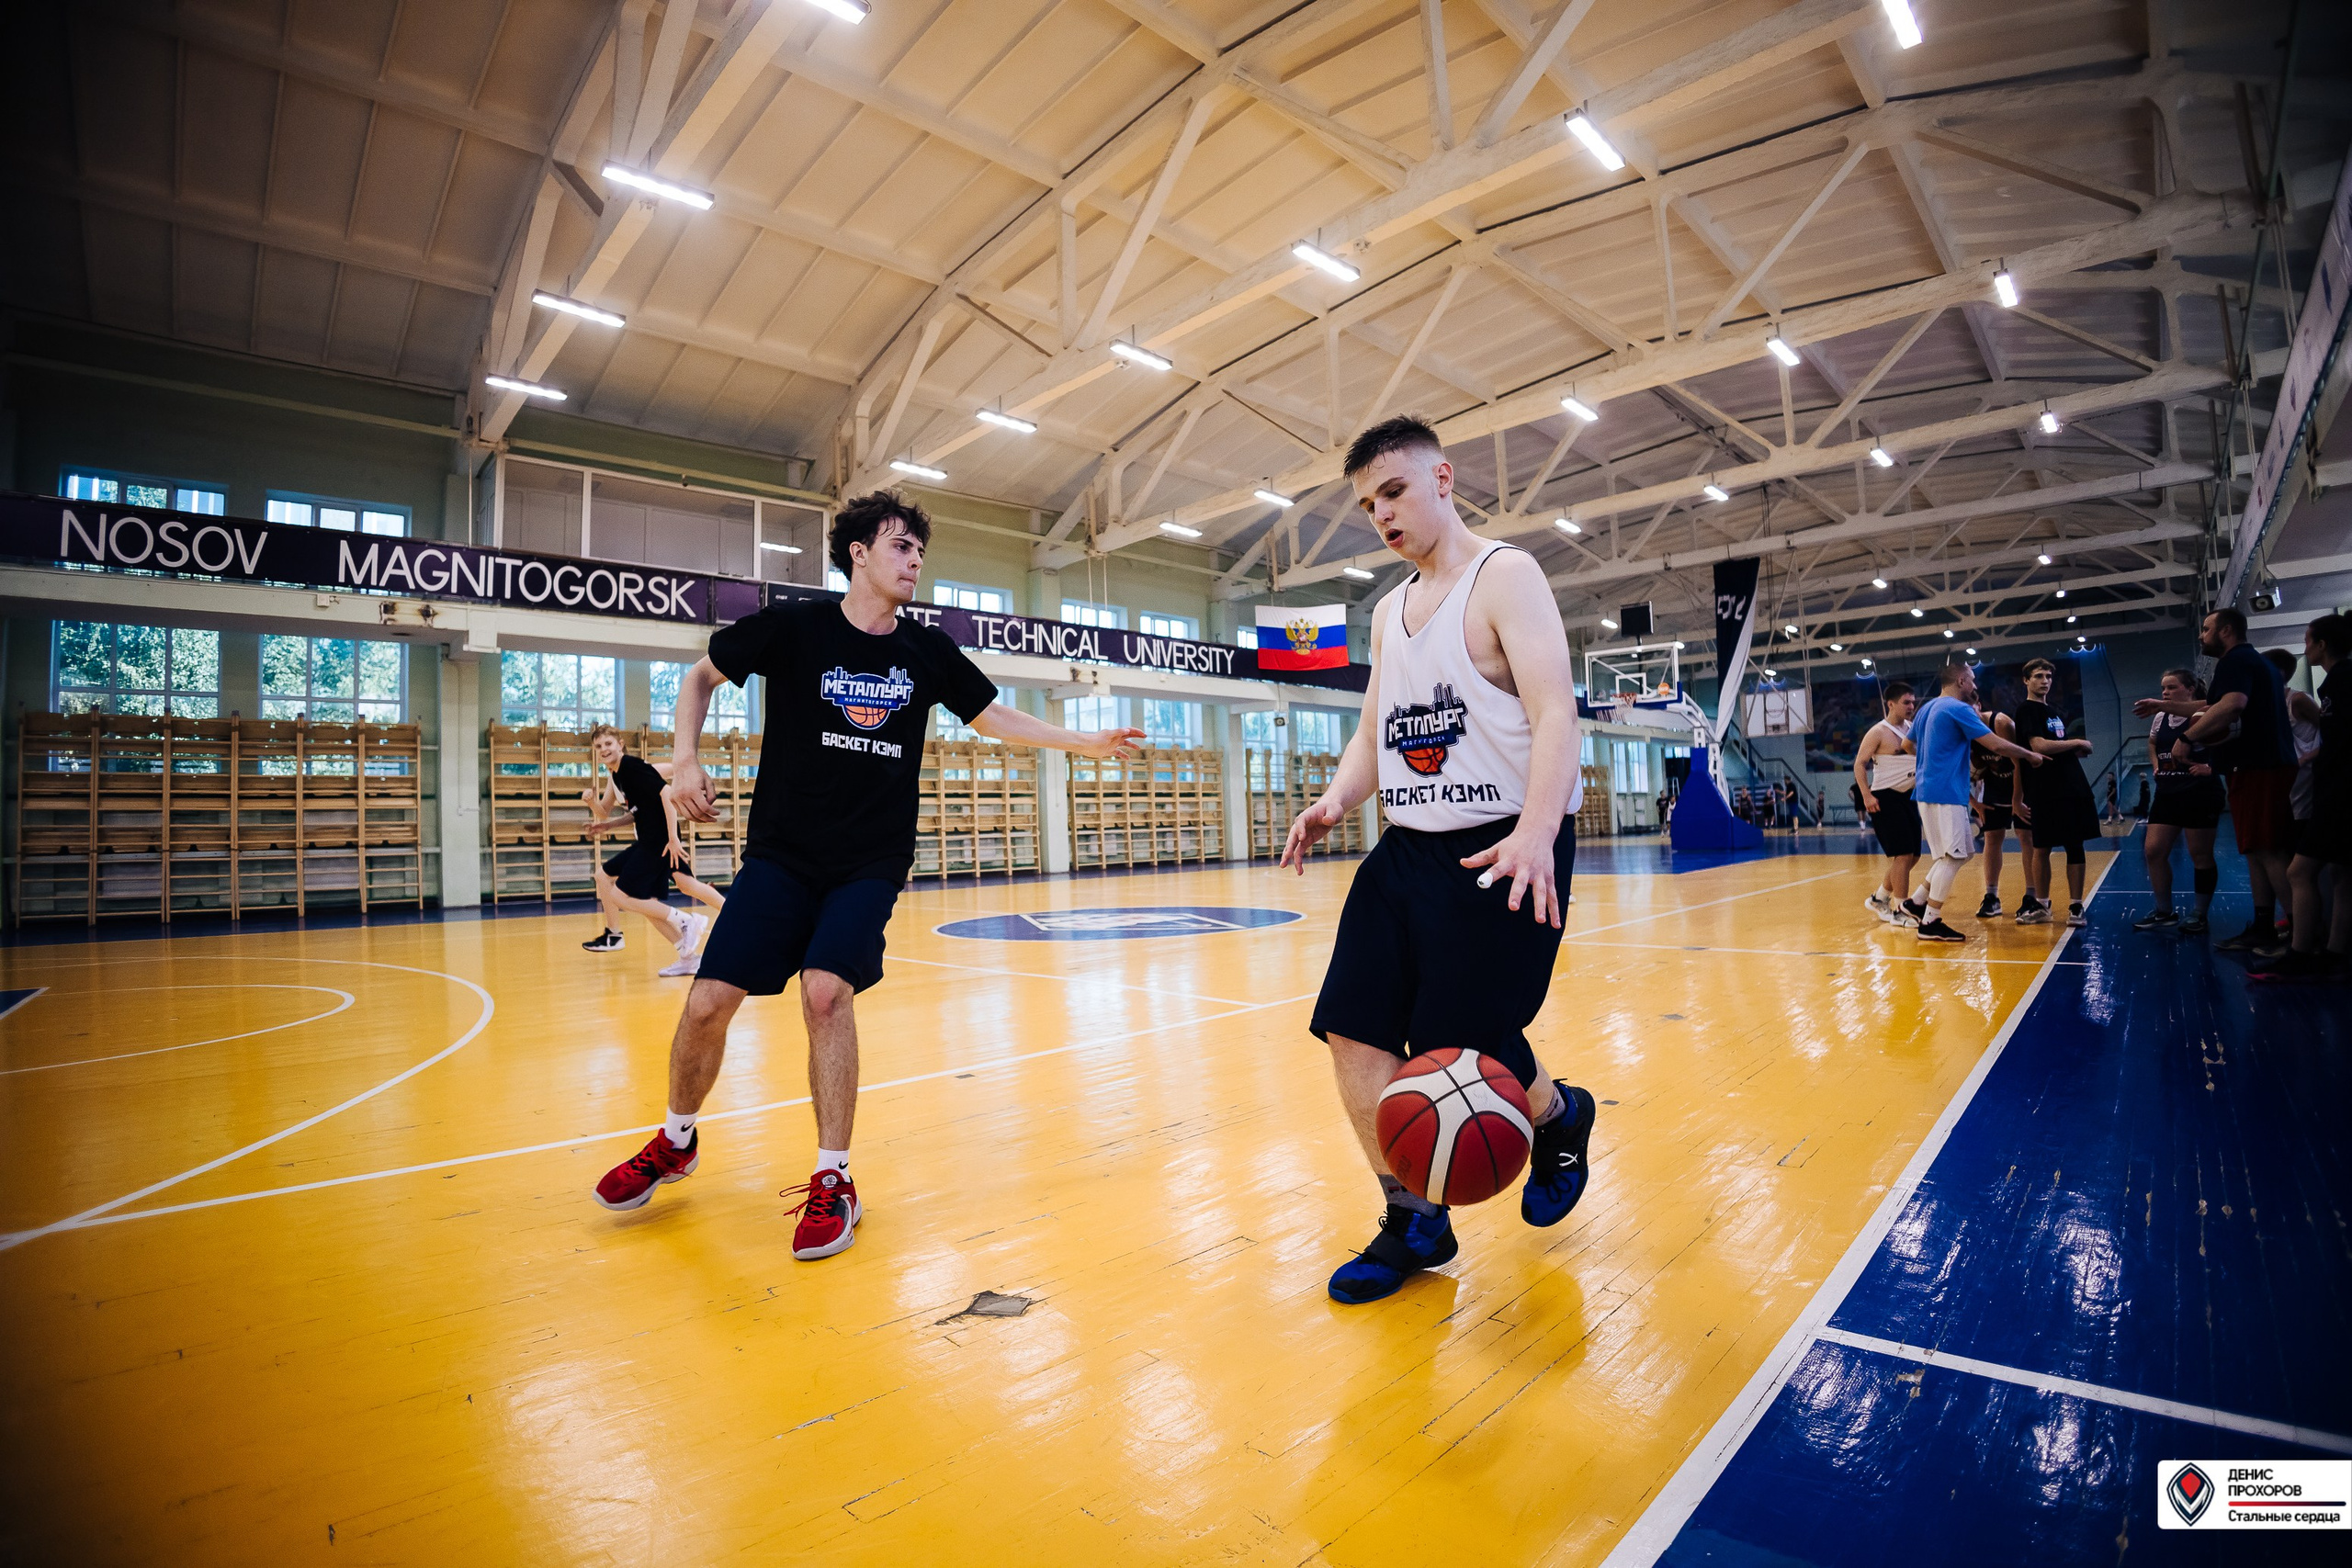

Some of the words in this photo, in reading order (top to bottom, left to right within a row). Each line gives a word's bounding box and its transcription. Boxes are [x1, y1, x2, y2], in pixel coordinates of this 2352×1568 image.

[60, 509, 268, 575] NOSOV
[337, 539, 696, 618] MAGNITOGORSK
[971, 615, 1109, 660] TECHNICAL
[1123, 634, 1235, 675] UNIVERSITY
[823, 678, 912, 700] МЕТАЛЛУРГ
[844, 697, 892, 706] МАГНИТОГОРСК
[821, 731, 871, 752] БАСКЕТ
[872, 739, 902, 759] КЭМП
[1442, 784, 1501, 804] КЭМП
